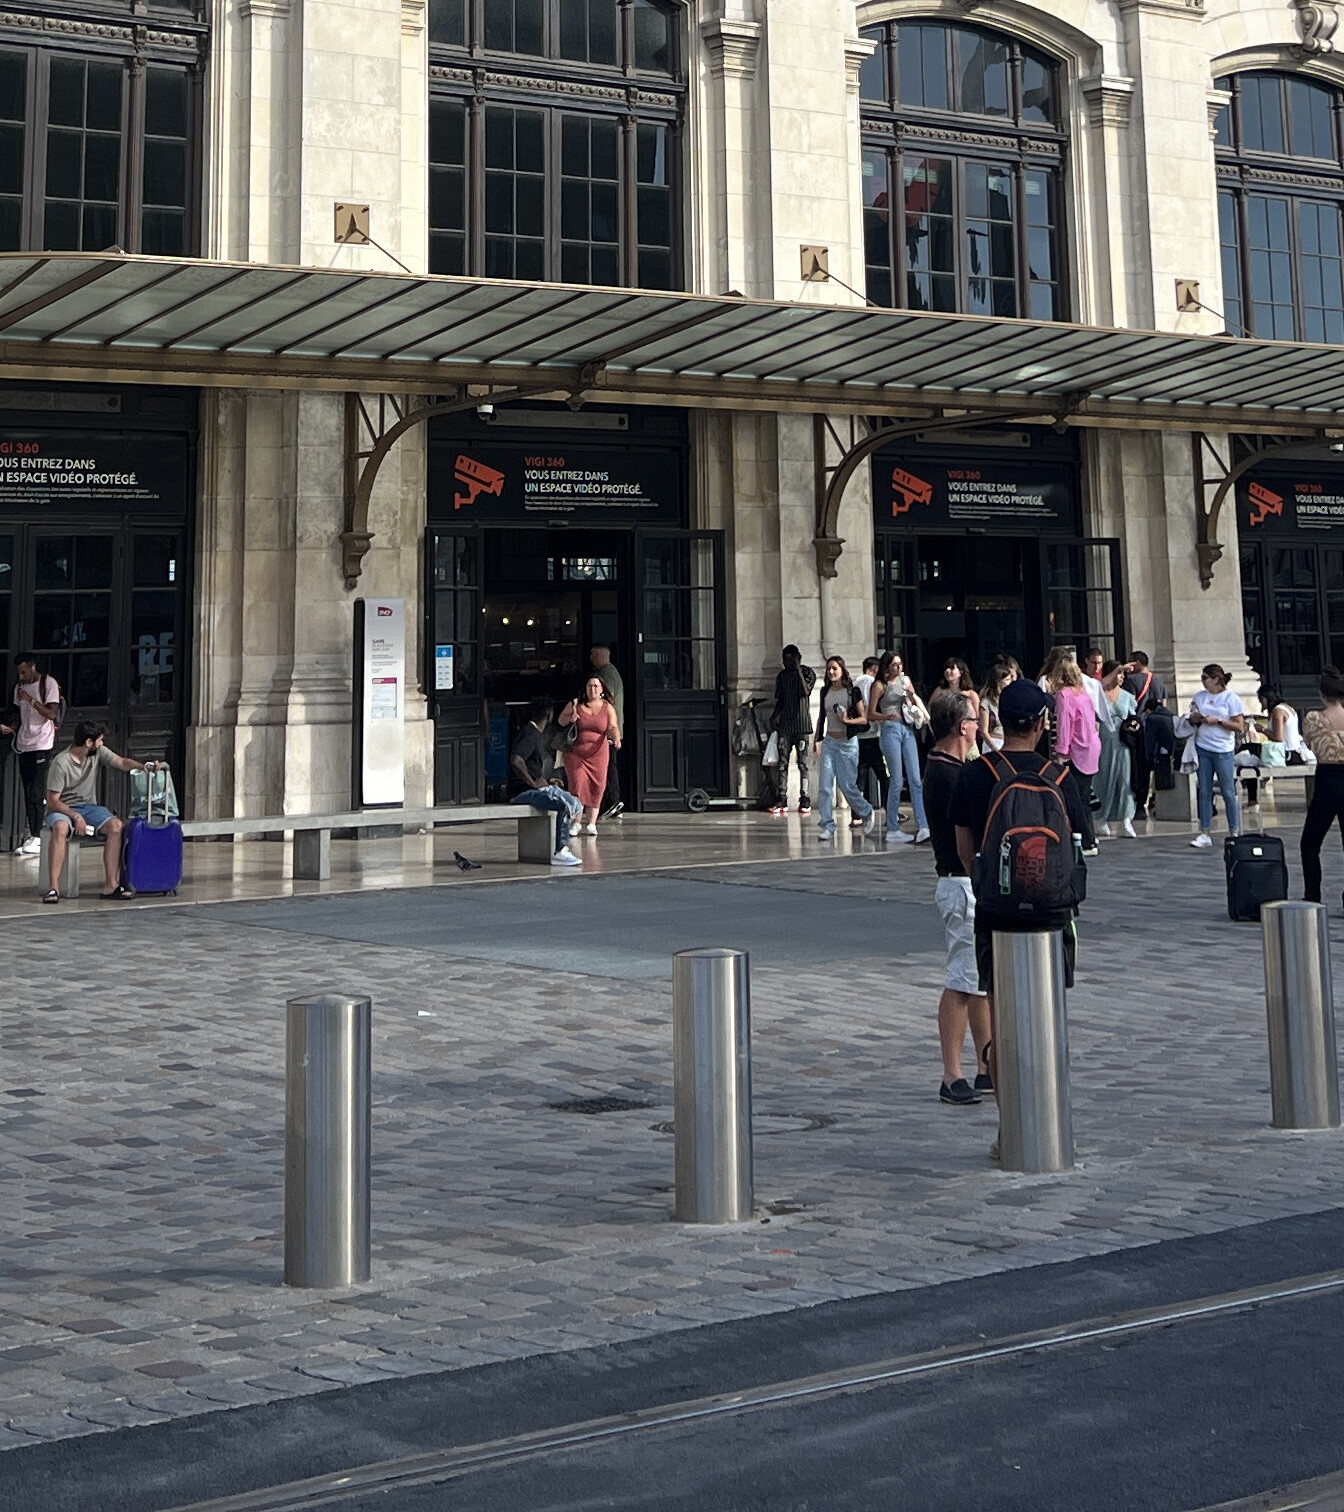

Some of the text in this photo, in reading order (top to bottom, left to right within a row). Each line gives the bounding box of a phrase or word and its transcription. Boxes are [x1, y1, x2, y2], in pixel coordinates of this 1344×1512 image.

[16, 443, 40, 454] 360
[21, 458, 63, 469] ENTREZ
[65, 459, 96, 470] DANS
[525, 456, 565, 467] VIGI 360
[6, 472, 47, 484] ESPACE
[49, 471, 84, 484] VIDÉO
[86, 471, 139, 485] PROTÉGÉ.
[525, 470, 609, 482] VOUS ENTREZ DANS
[525, 482, 643, 494] UN ESPACE VIDÉO PROTÉGÉ.
[948, 482, 1016, 493] VOUS ENTREZ DANS
[949, 494, 960, 502] UN
[961, 494, 987, 503] ESPACE
[988, 494, 1010, 504] VIDÉO
